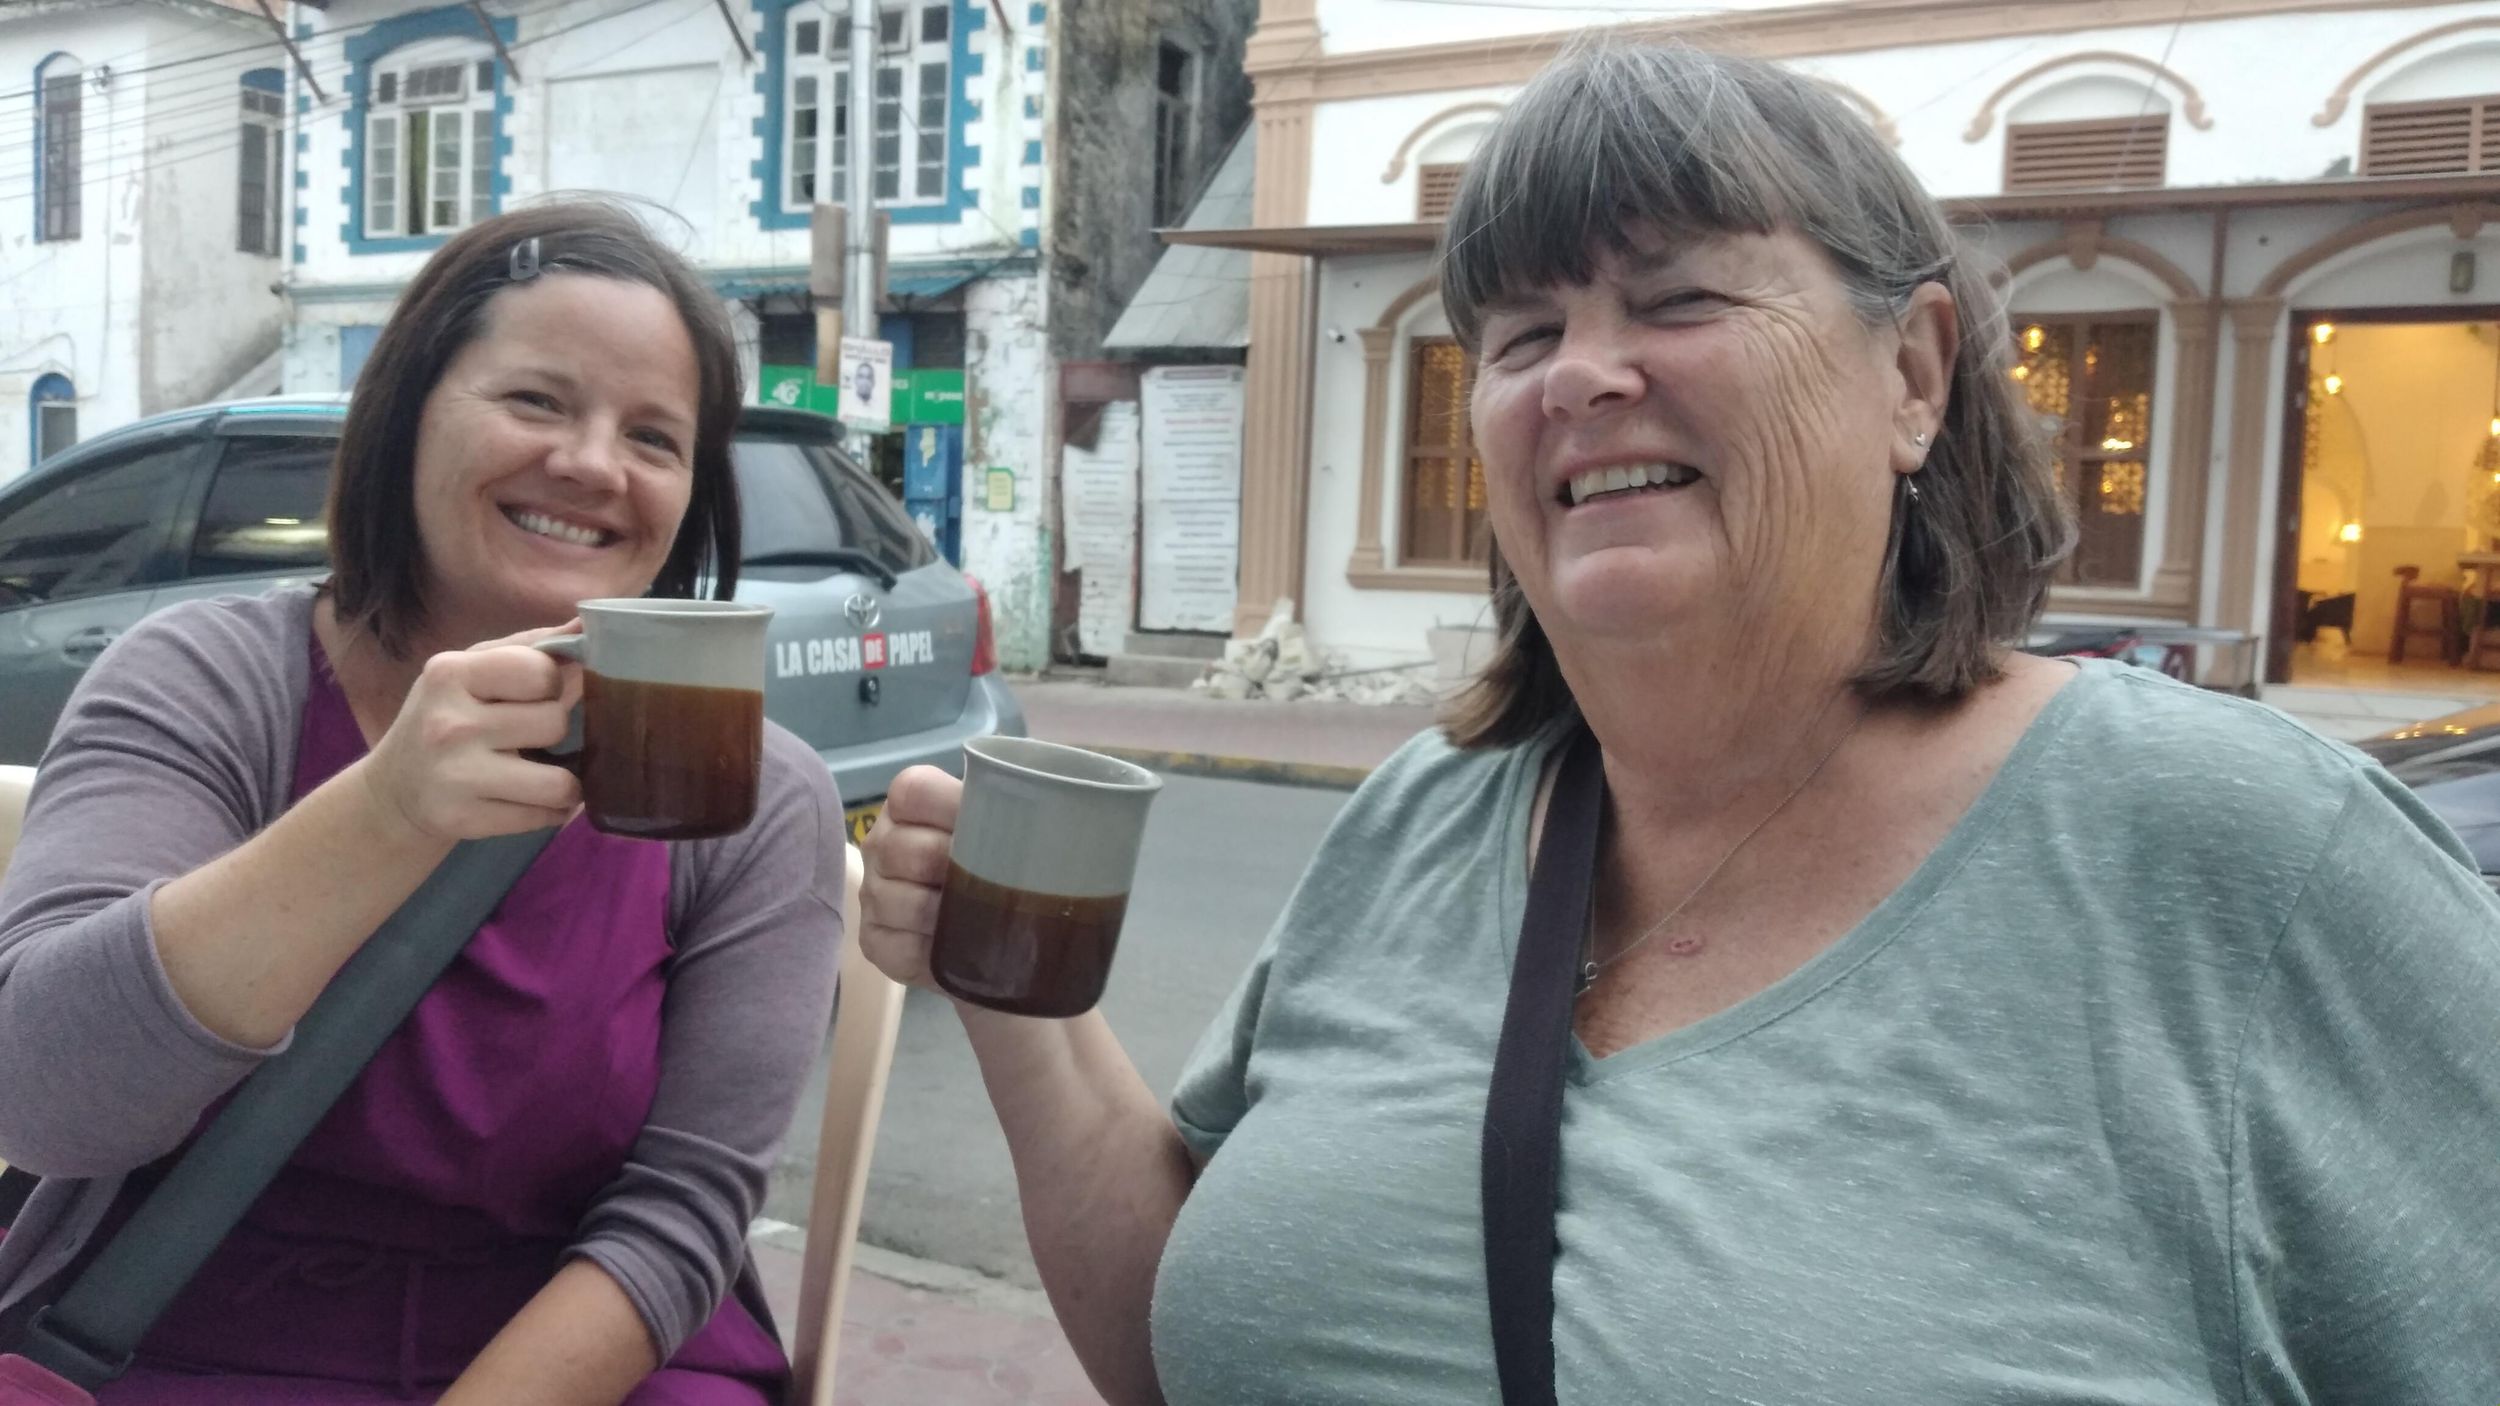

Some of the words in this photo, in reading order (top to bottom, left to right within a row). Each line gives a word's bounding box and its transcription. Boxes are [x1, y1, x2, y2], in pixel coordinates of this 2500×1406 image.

[776, 641, 804, 678] LA
[806, 637, 861, 675] CASA
[864, 639, 884, 664] DE
[888, 631, 934, 667] PAPEL
